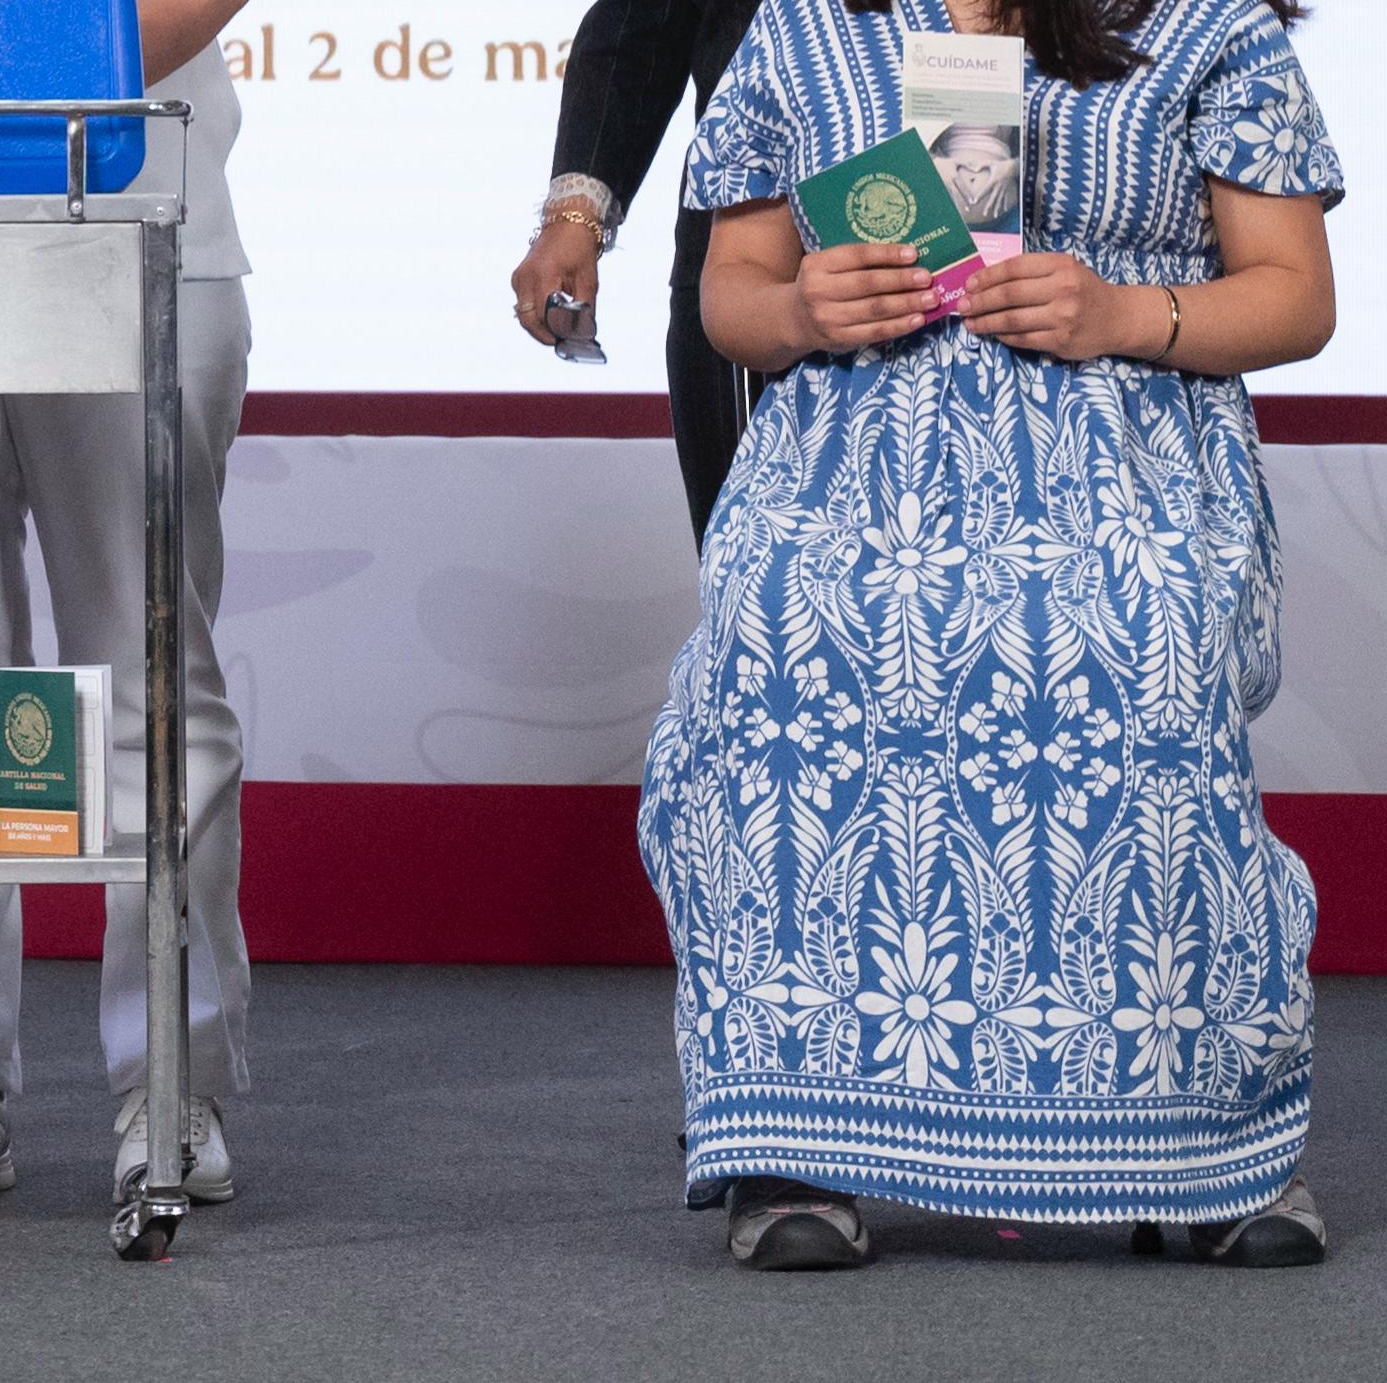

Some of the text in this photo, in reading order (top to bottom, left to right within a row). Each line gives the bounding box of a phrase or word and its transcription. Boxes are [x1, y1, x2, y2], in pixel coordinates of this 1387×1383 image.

[308, 31, 342, 81] 2
[373, 23, 453, 82] de
[927, 55, 998, 71] CUÍDAME
